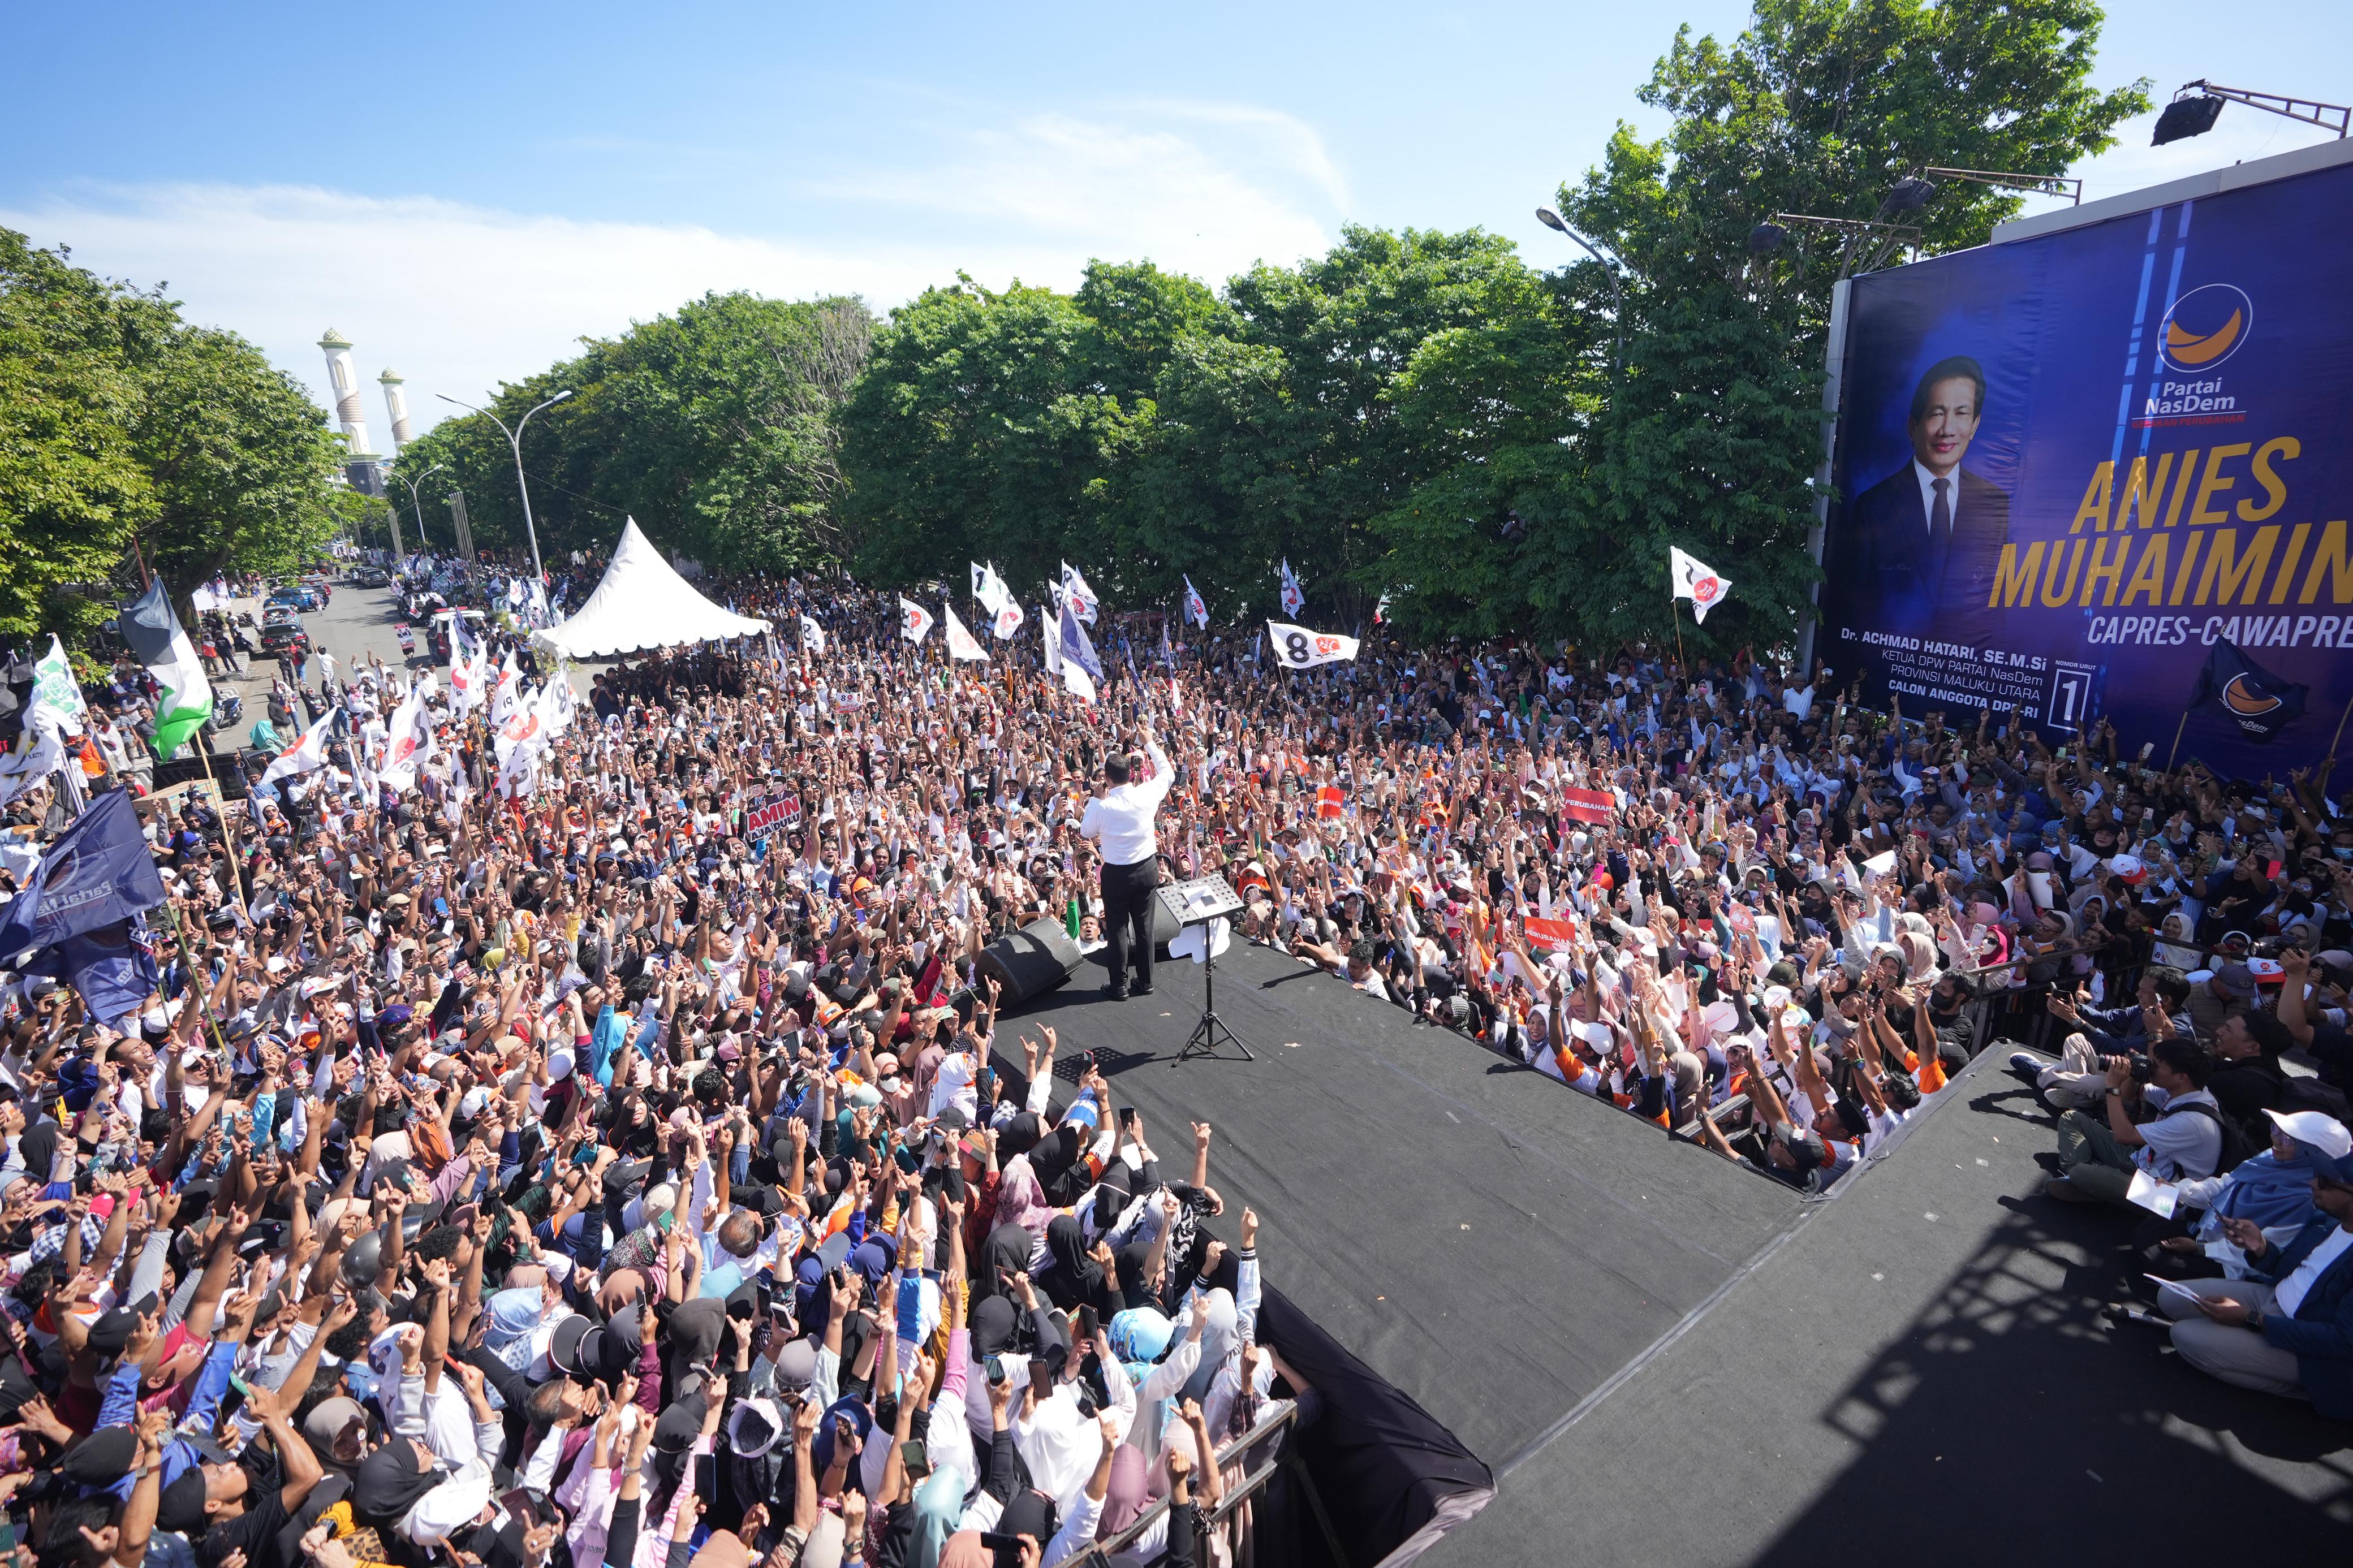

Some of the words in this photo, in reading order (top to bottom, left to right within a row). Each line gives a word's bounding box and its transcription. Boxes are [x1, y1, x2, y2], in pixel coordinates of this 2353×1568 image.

[2163, 377, 2222, 396] Partai
[2145, 395, 2235, 414] NasDem
[2179, 415, 2245, 425] PERUBAHAN
[2068, 436, 2301, 534] ANIES
[1054, 590, 1063, 610] 8
[1286, 632, 1309, 663] 8
[1841, 628, 1858, 641] Dr.
[1861, 631, 1919, 651] ACHMAD
[1924, 641, 1978, 662] HATARI,
[1984, 650, 2046, 671] SE.M.Si
[1882, 649, 1915, 663] KETUA
[1919, 655, 1945, 669] DPW
[1948, 661, 1986, 677] PARTAI
[1990, 667, 2042, 686] NasDem
[2055, 660, 2078, 668] NOMOR
[1888, 680, 1926, 696] CALON
[1929, 688, 1988, 708] ANGGOTA
[1890, 664, 1939, 683] PROVINSI
[1943, 673, 1994, 693] MALUKU
[1999, 684, 2040, 701] UTARA
[2062, 680, 2078, 721] 1
[2238, 719, 2269, 732] sDem
[749, 796, 800, 831] AMIN
[1565, 799, 1611, 811] PERUBAHAN
[752, 826, 772, 841] AJA
[773, 813, 800, 831] DULU
